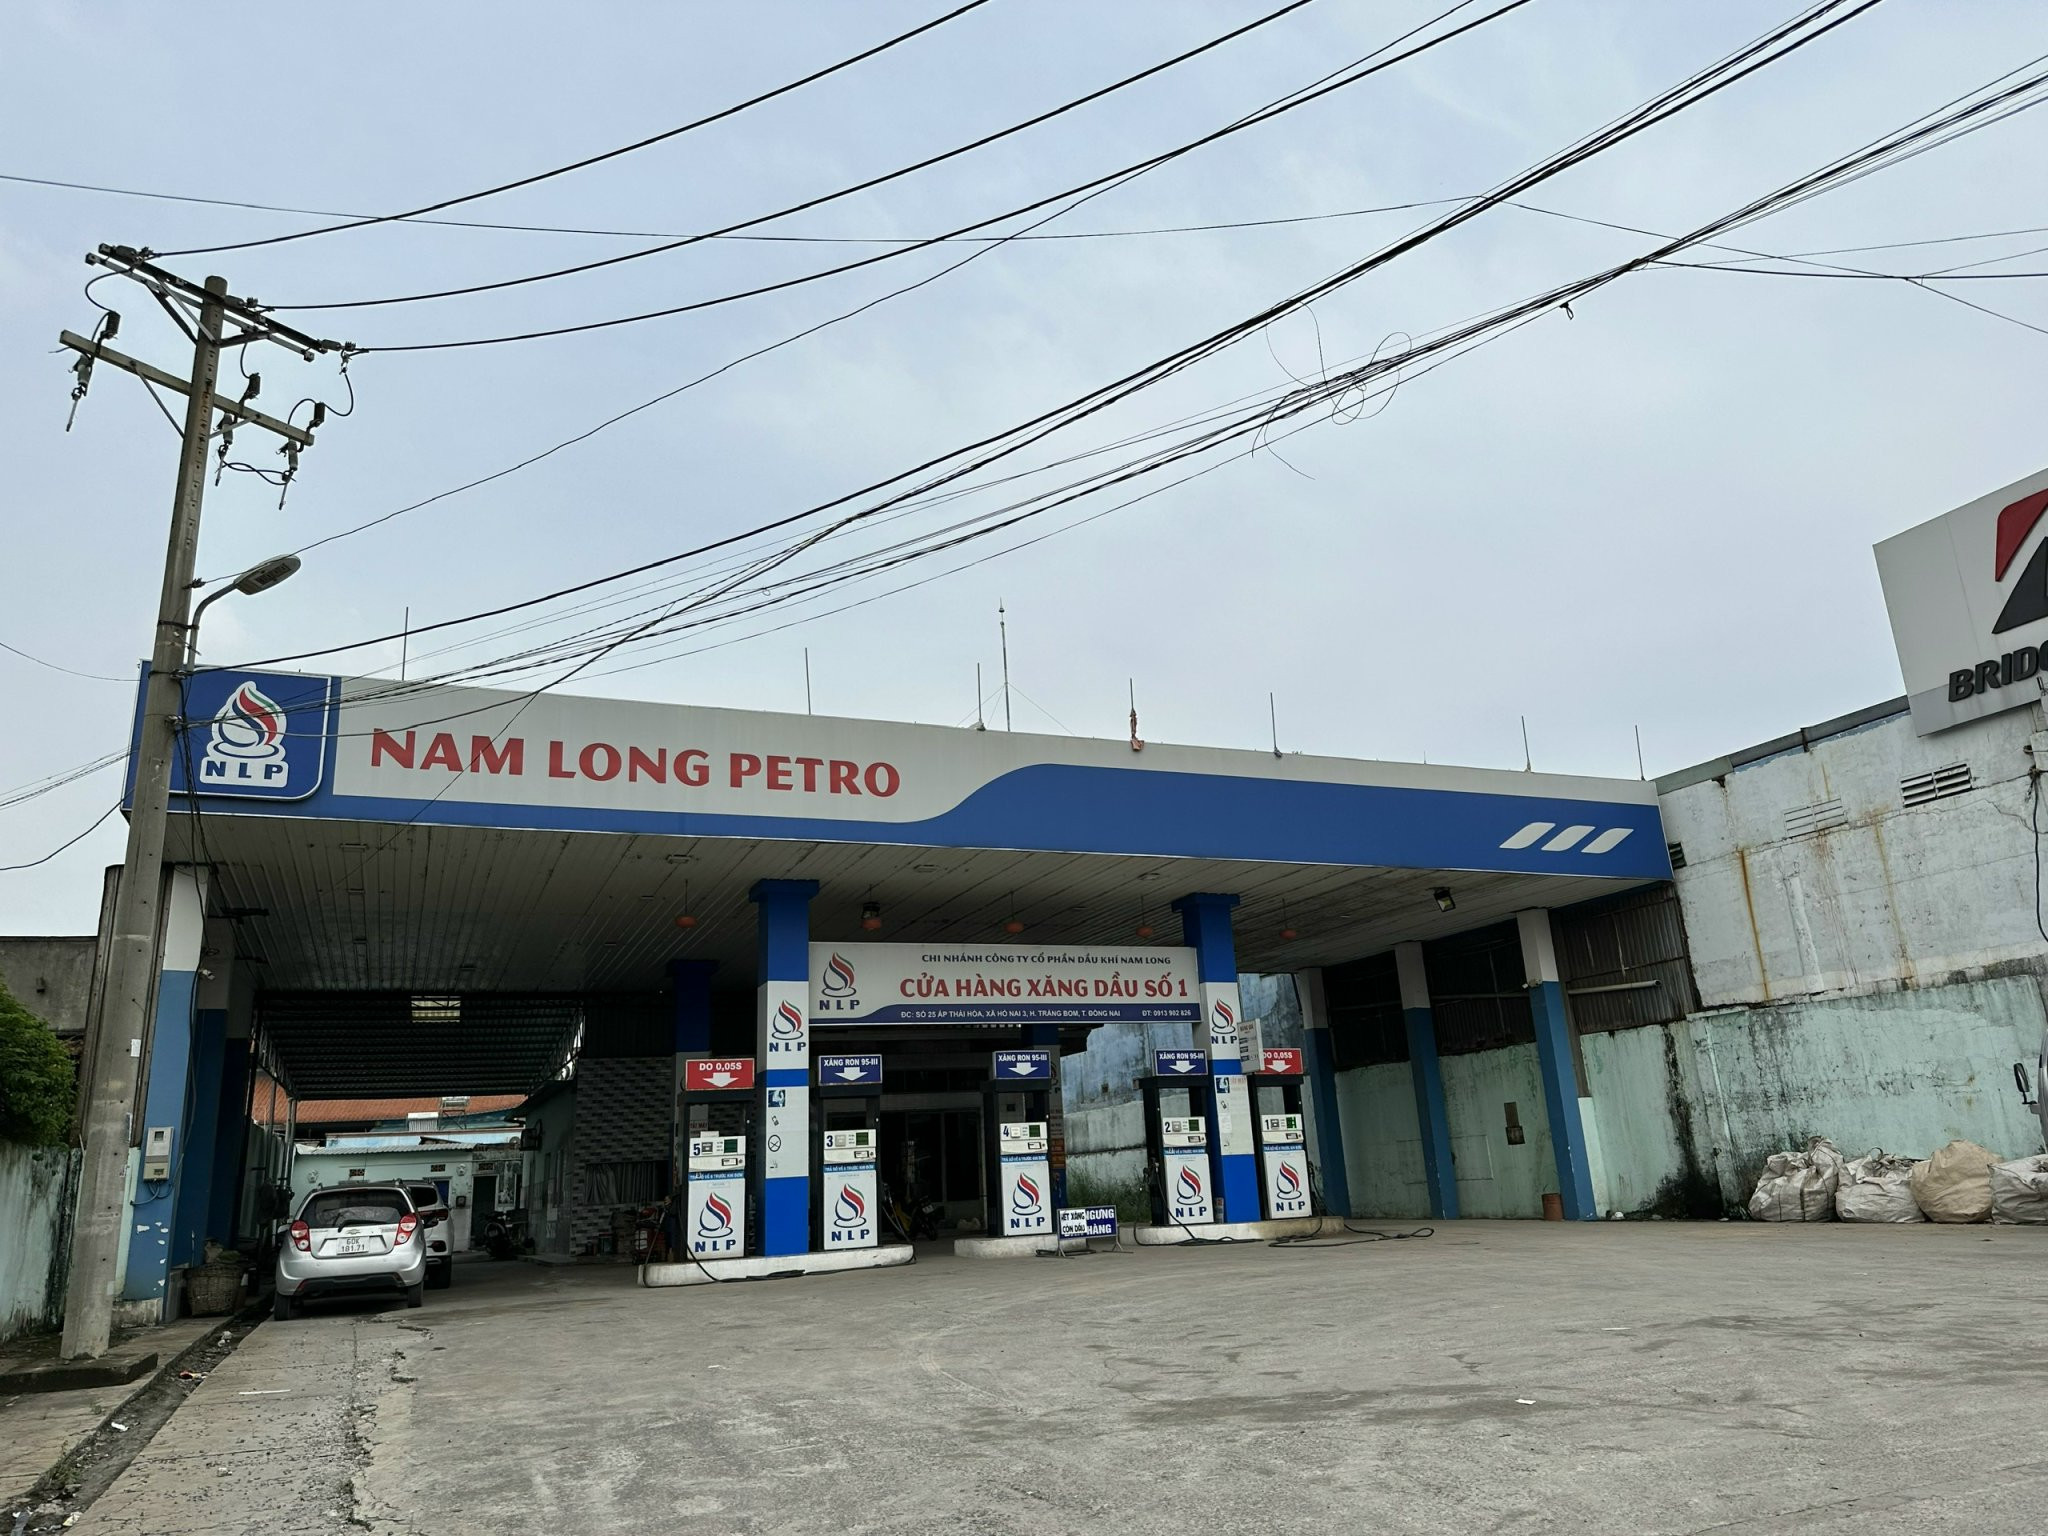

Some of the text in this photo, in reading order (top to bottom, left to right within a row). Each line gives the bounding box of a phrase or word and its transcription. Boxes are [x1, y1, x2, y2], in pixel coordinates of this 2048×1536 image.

[371, 728, 901, 798] NAM LONG PETRO
[205, 760, 284, 780] NLP
[922, 954, 941, 962] CHI
[944, 952, 983, 963] NHÁNH
[1016, 955, 1028, 963] TY
[1101, 953, 1118, 964] KHÍ
[1121, 956, 1143, 964] NAM
[1145, 956, 1171, 964] LONG
[900, 971, 1188, 997] CỬA HÀNG XĂNG DẦU SỐ 1
[819, 999, 860, 1010] NLP
[1211, 1035, 1238, 1044] NLP
[768, 1042, 806, 1052] NLP
[1017, 1053, 1031, 1061] RON
[1176, 1052, 1189, 1060] RON
[699, 1062, 742, 1072] DO 0,05S
[845, 1058, 859, 1066] RON
[1164, 1122, 1171, 1133] 2
[1265, 1119, 1270, 1130] 1
[1003, 1126, 1010, 1137] 4
[826, 1135, 833, 1147] 3
[693, 1143, 701, 1156] 5
[1175, 1206, 1207, 1217] NLP
[1275, 1201, 1306, 1212] NLP
[1010, 1216, 1045, 1229] NLP
[1086, 1223, 1112, 1235] HÀNG
[831, 1229, 870, 1242] NLP
[694, 1239, 737, 1252] NLP
